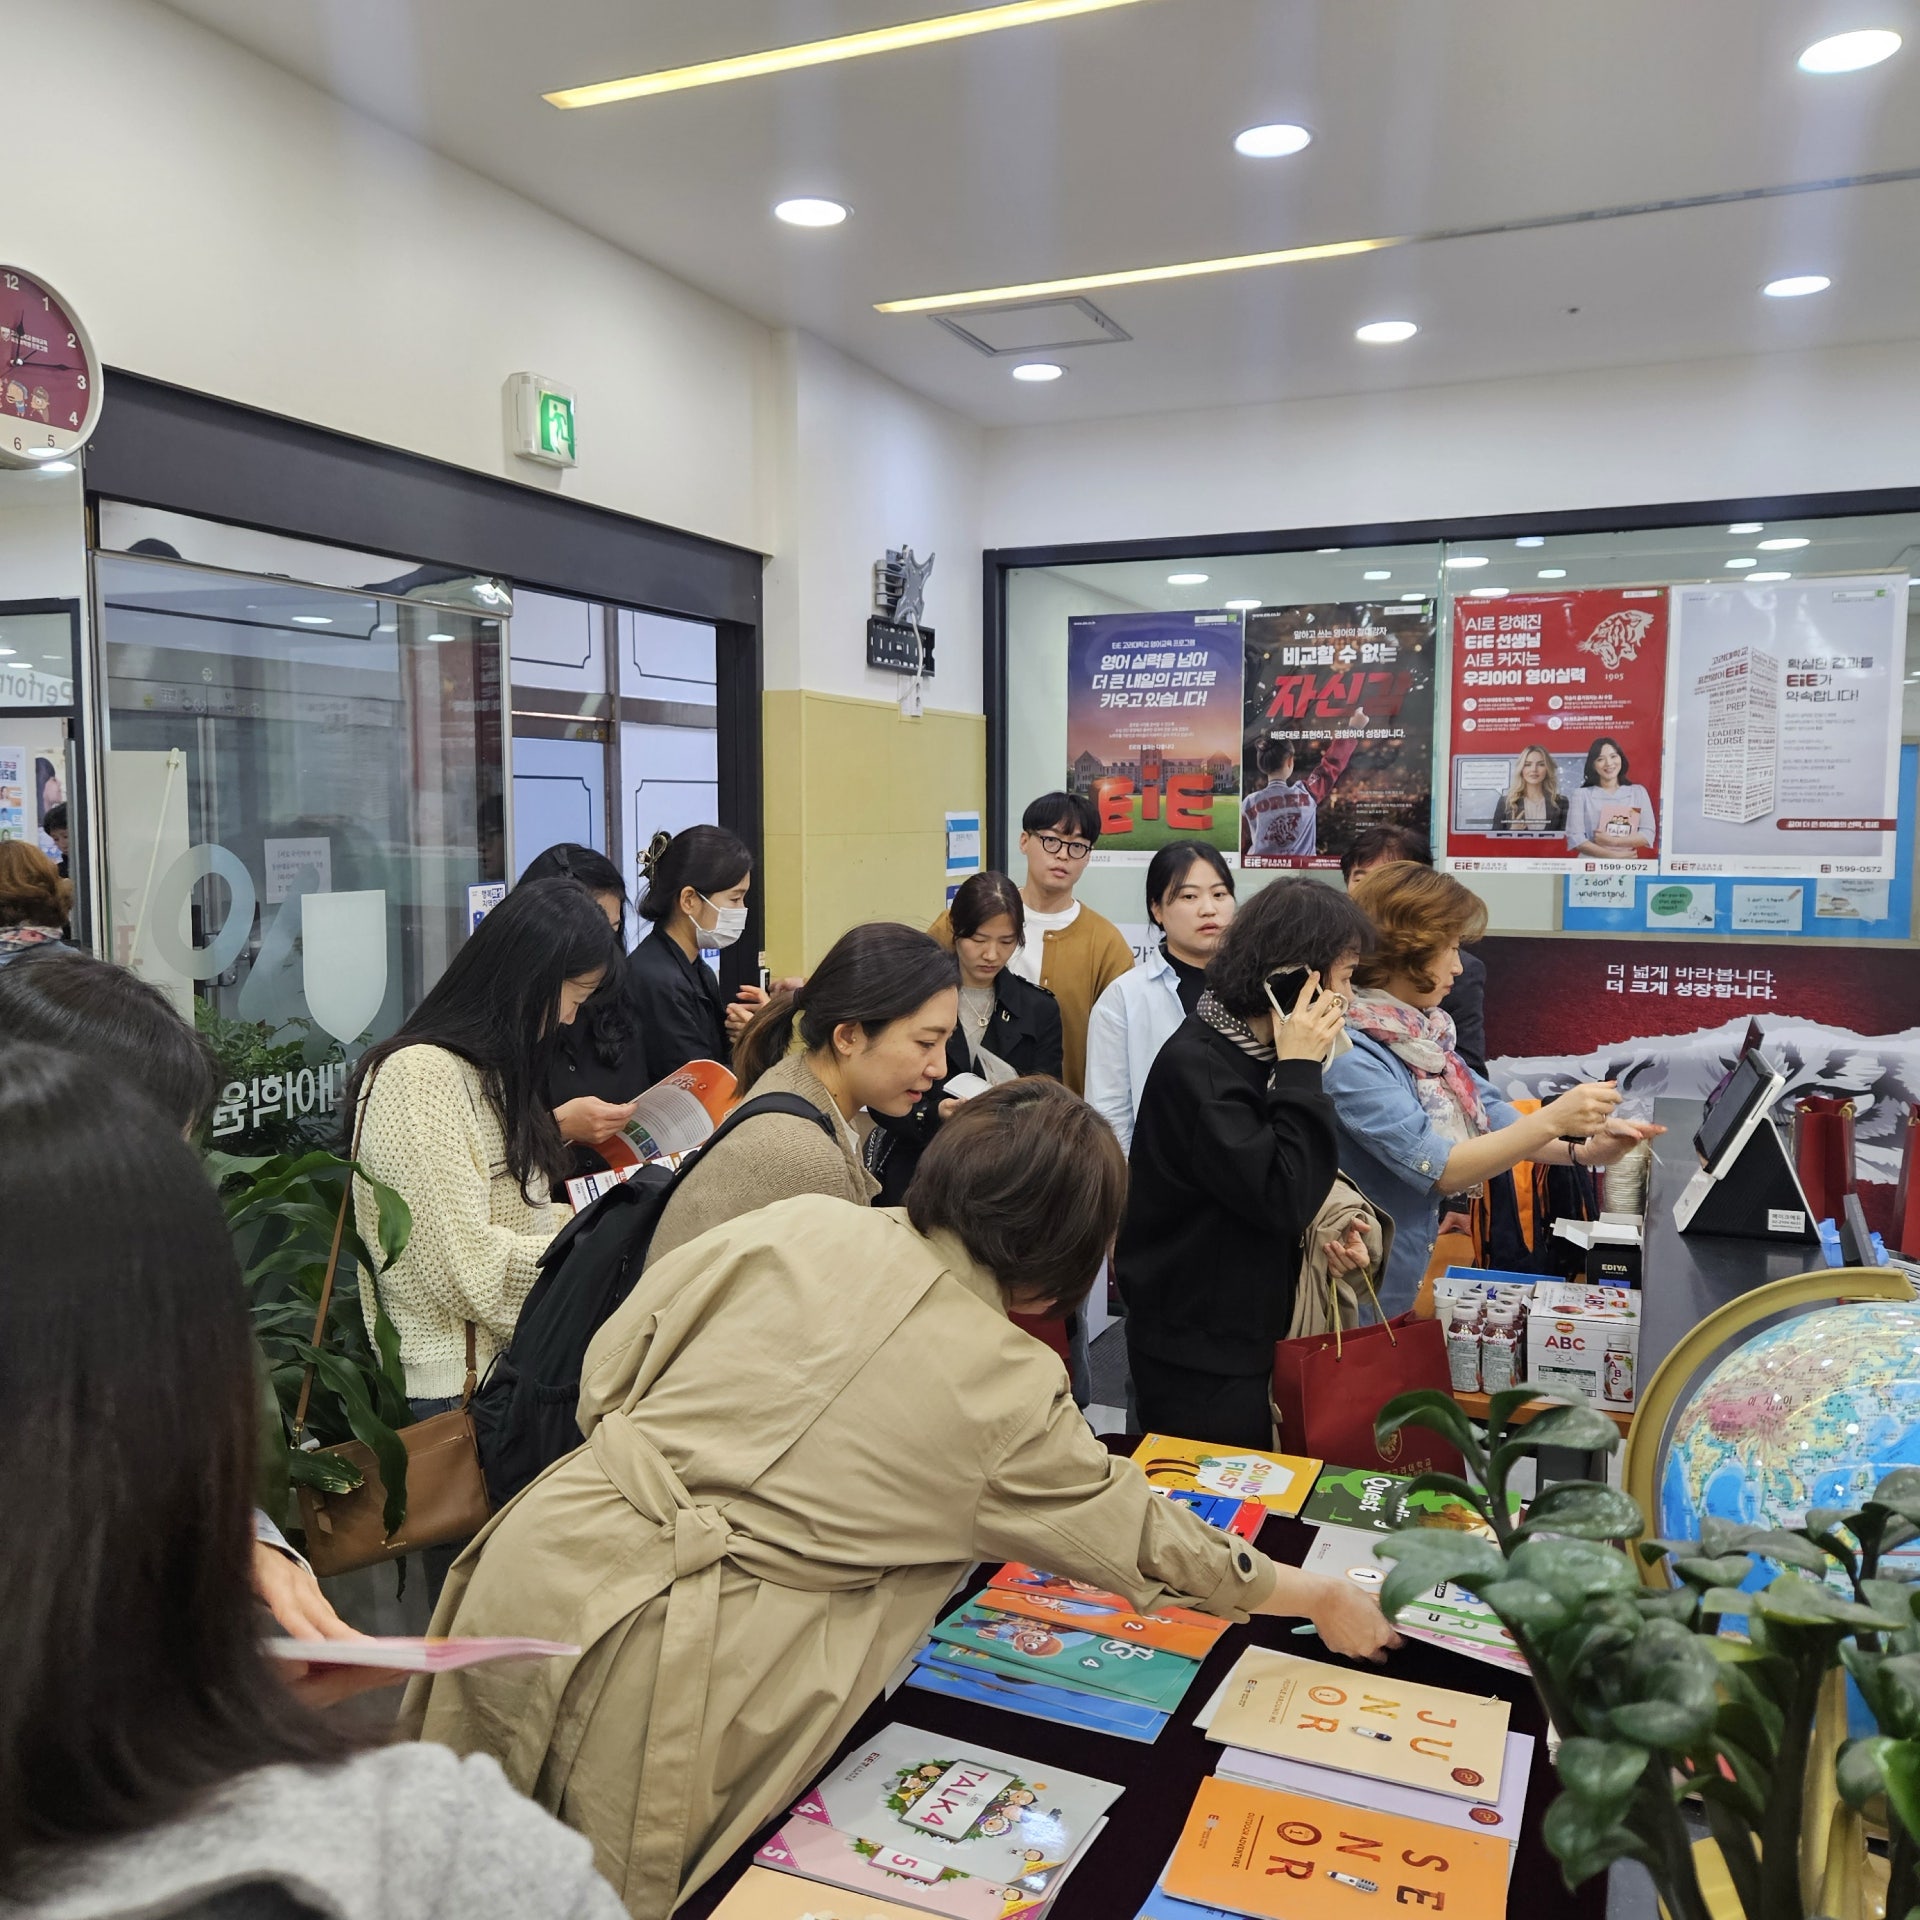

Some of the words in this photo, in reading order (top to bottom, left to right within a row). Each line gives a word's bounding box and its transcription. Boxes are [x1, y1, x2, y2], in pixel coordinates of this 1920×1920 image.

[4, 274, 19, 291] 12
[43, 297, 49, 311] 1
[67, 333, 76, 348] 2
[77, 375, 86, 390] 3
[69, 411, 78, 426] 4
[13, 437, 22, 450] 6
[47, 434, 55, 448] 5
[1465, 616, 1495, 632] AI로
[1498, 614, 1542, 630] 강해진
[1464, 634, 1495, 650] EiE
[1496, 632, 1541, 649] 선생님
[1101, 654, 1130, 671] 영어
[1132, 653, 1176, 670] 실력을
[1177, 651, 1208, 668] 넘어
[1283, 645, 1335, 666] 비교할
[1338, 645, 1357, 664] 수
[1360, 643, 1398, 664] 없는
[1464, 652, 1495, 668] AI로
[1497, 651, 1541, 667] 커지는
[1463, 670, 1522, 687] 우리아이
[1525, 667, 1586, 686] 영어실력
[1604, 673, 1624, 682] 1905
[1725, 662, 1749, 679] EiE
[1092, 674, 1108, 690] 더
[1109, 673, 1124, 690] 큰
[1126, 672, 1171, 689] 내일의
[1171, 671, 1217, 687] 리더로
[1786, 673, 1833, 688] EiE가
[1100, 692, 1143, 708] 키우고
[1144, 690, 1208, 708] 있습니다!
[1785, 689, 1860, 702] 약속합니다!
[1726, 701, 1747, 712] PREP
[1365, 728, 1406, 739] 성장합니다.
[1707, 728, 1746, 739] LEADERS
[1707, 736, 1745, 746] COURSE
[1090, 764, 1214, 836] EiE
[1244, 858, 1261, 868] EiE
[1454, 861, 1473, 871] EiE
[1599, 863, 1648, 872] 1599-0572
[1670, 863, 1689, 871] EiE
[1835, 865, 1883, 873] 1599-0572
[1132, 945, 1155, 963] 가
[1607, 964, 1625, 978] 더
[1633, 965, 1669, 980] 넓게
[1675, 967, 1777, 984] 바라봅니다.
[1606, 980, 1624, 994] 더
[1629, 980, 1668, 996] 크게
[1674, 982, 1778, 1000] 성장합니다.
[1601, 1263, 1628, 1272] EDIYA
[1584, 1293, 1605, 1310] ABC
[1544, 1335, 1586, 1351] ABC
[1554, 1354, 1576, 1366] 주스
[1609, 1361, 1622, 1386] ABC
[1216, 1461, 1247, 1490] FIRST
[1240, 1462, 1273, 1494] SOUND
[1358, 1477, 1393, 1513] Quest
[1329, 1507, 1353, 1522] 1
[1354, 1571, 1377, 1579] 1
[1124, 1621, 1144, 1632] 2
[1082, 1658, 1100, 1669] 4
[797, 1802, 822, 1814] 4
[1242, 1812, 1256, 1836] OUTDOOR
[762, 1846, 788, 1861] 5
[1231, 1835, 1247, 1869] ADVENTURE
[891, 1854, 918, 1869] 5
